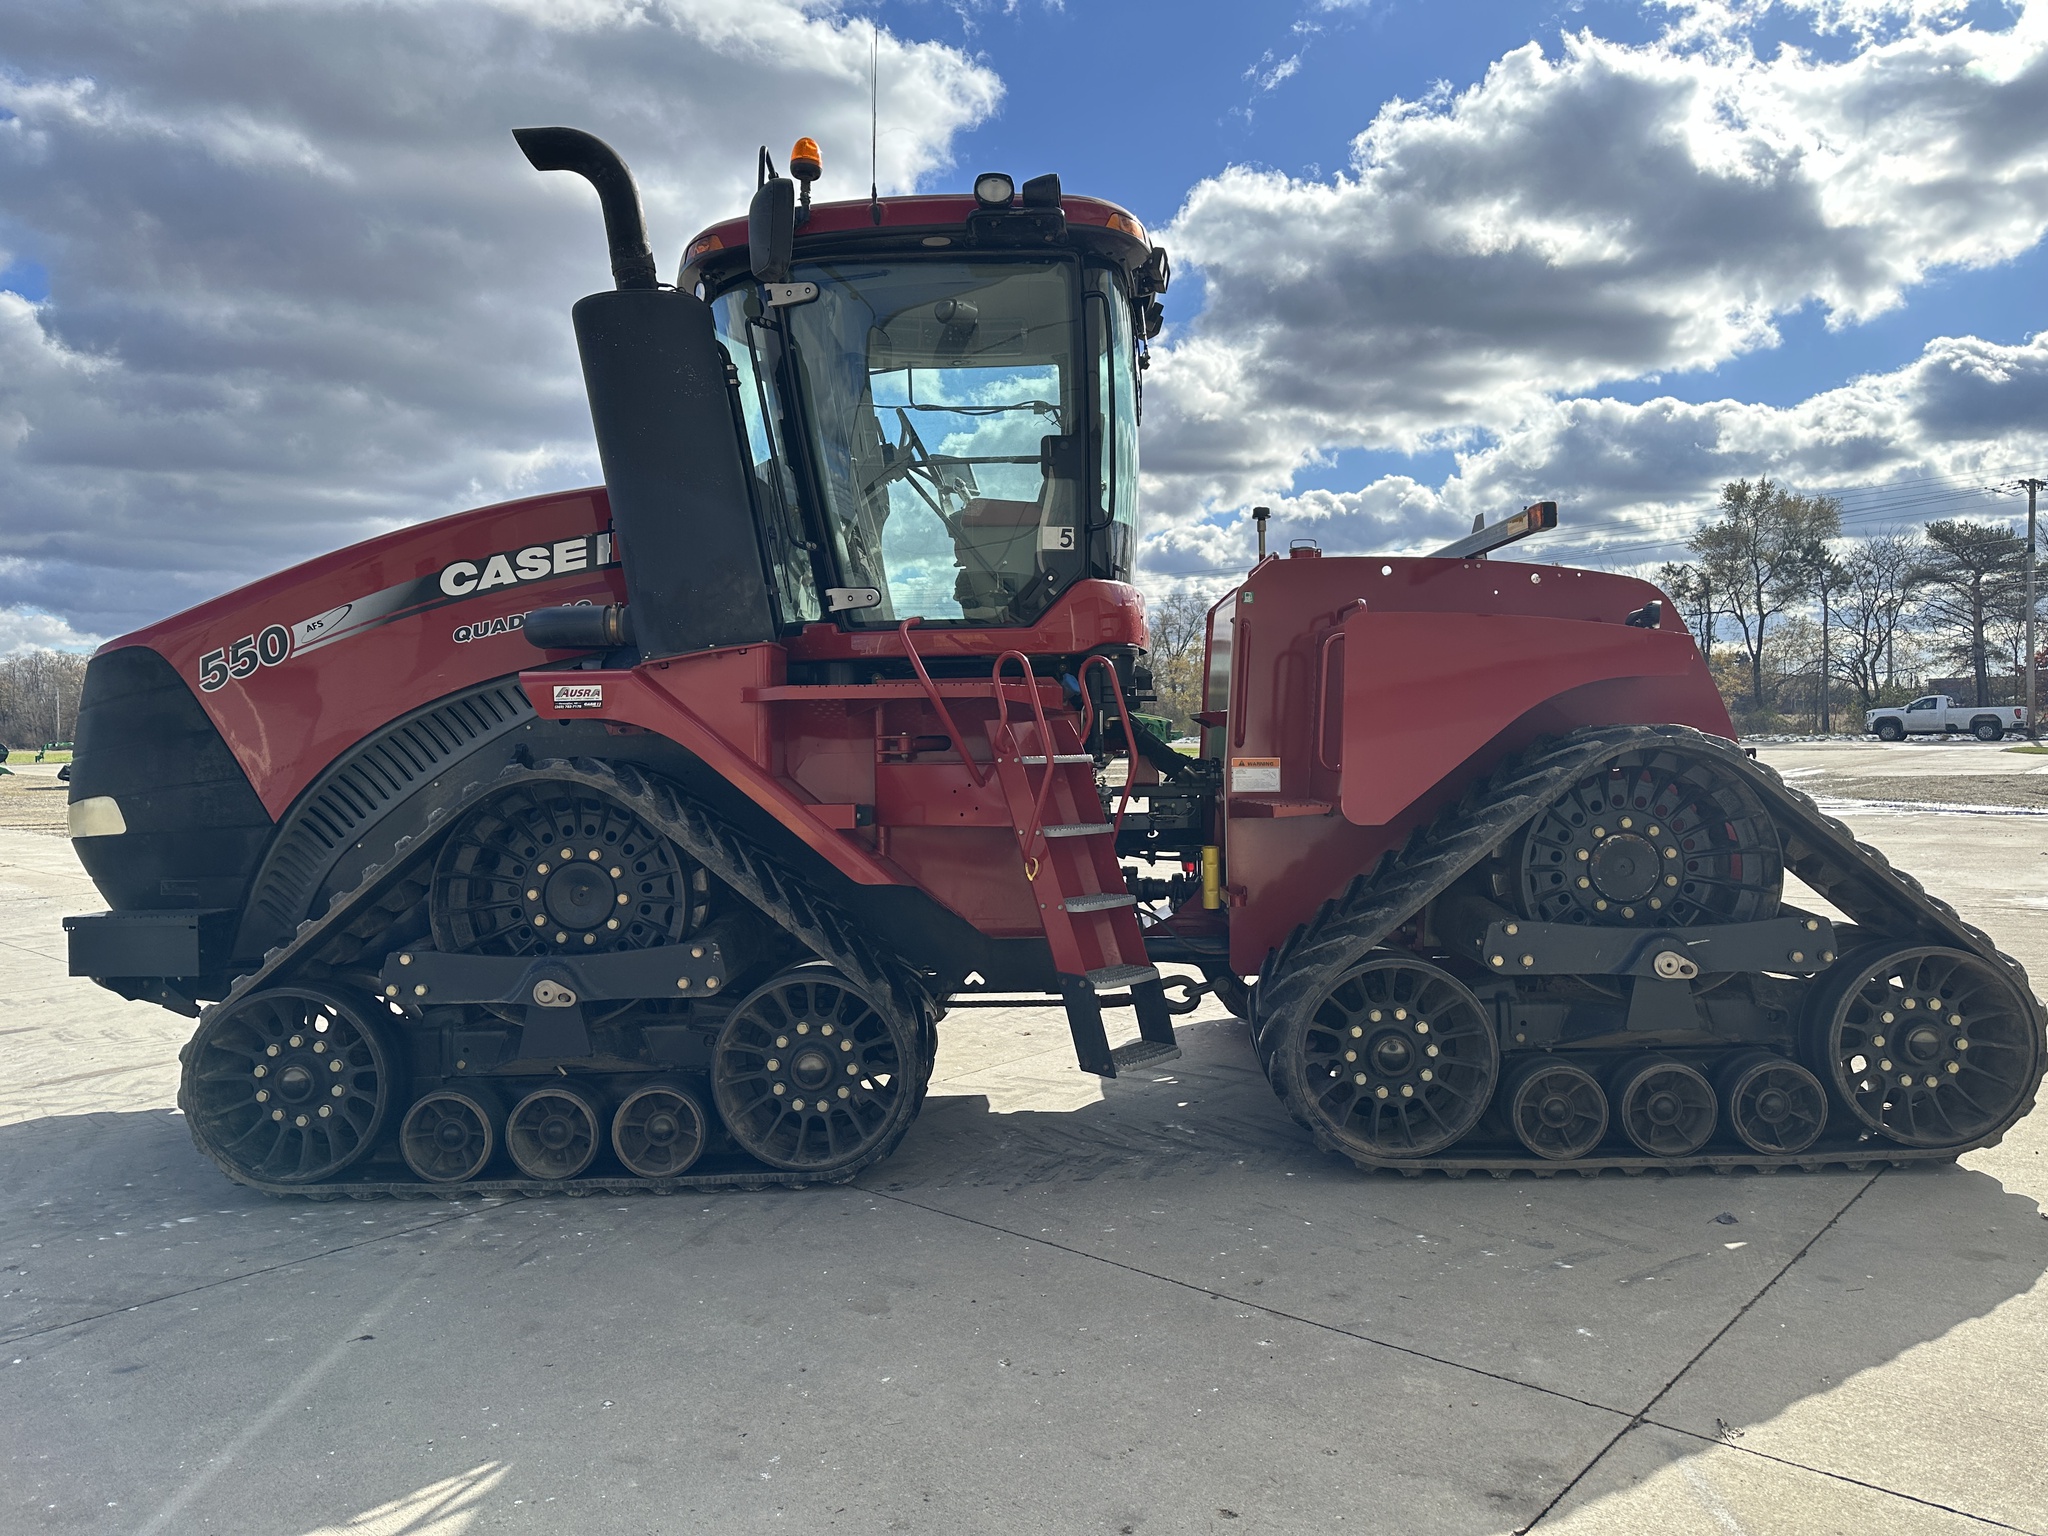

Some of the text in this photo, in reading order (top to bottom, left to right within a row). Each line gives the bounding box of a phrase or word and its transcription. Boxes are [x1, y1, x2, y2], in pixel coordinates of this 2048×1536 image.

[1059, 528, 1073, 548] 5
[439, 538, 587, 596] CASE
[306, 620, 324, 633] AFS
[199, 623, 291, 693] 550
[555, 687, 601, 698] AUSRA
